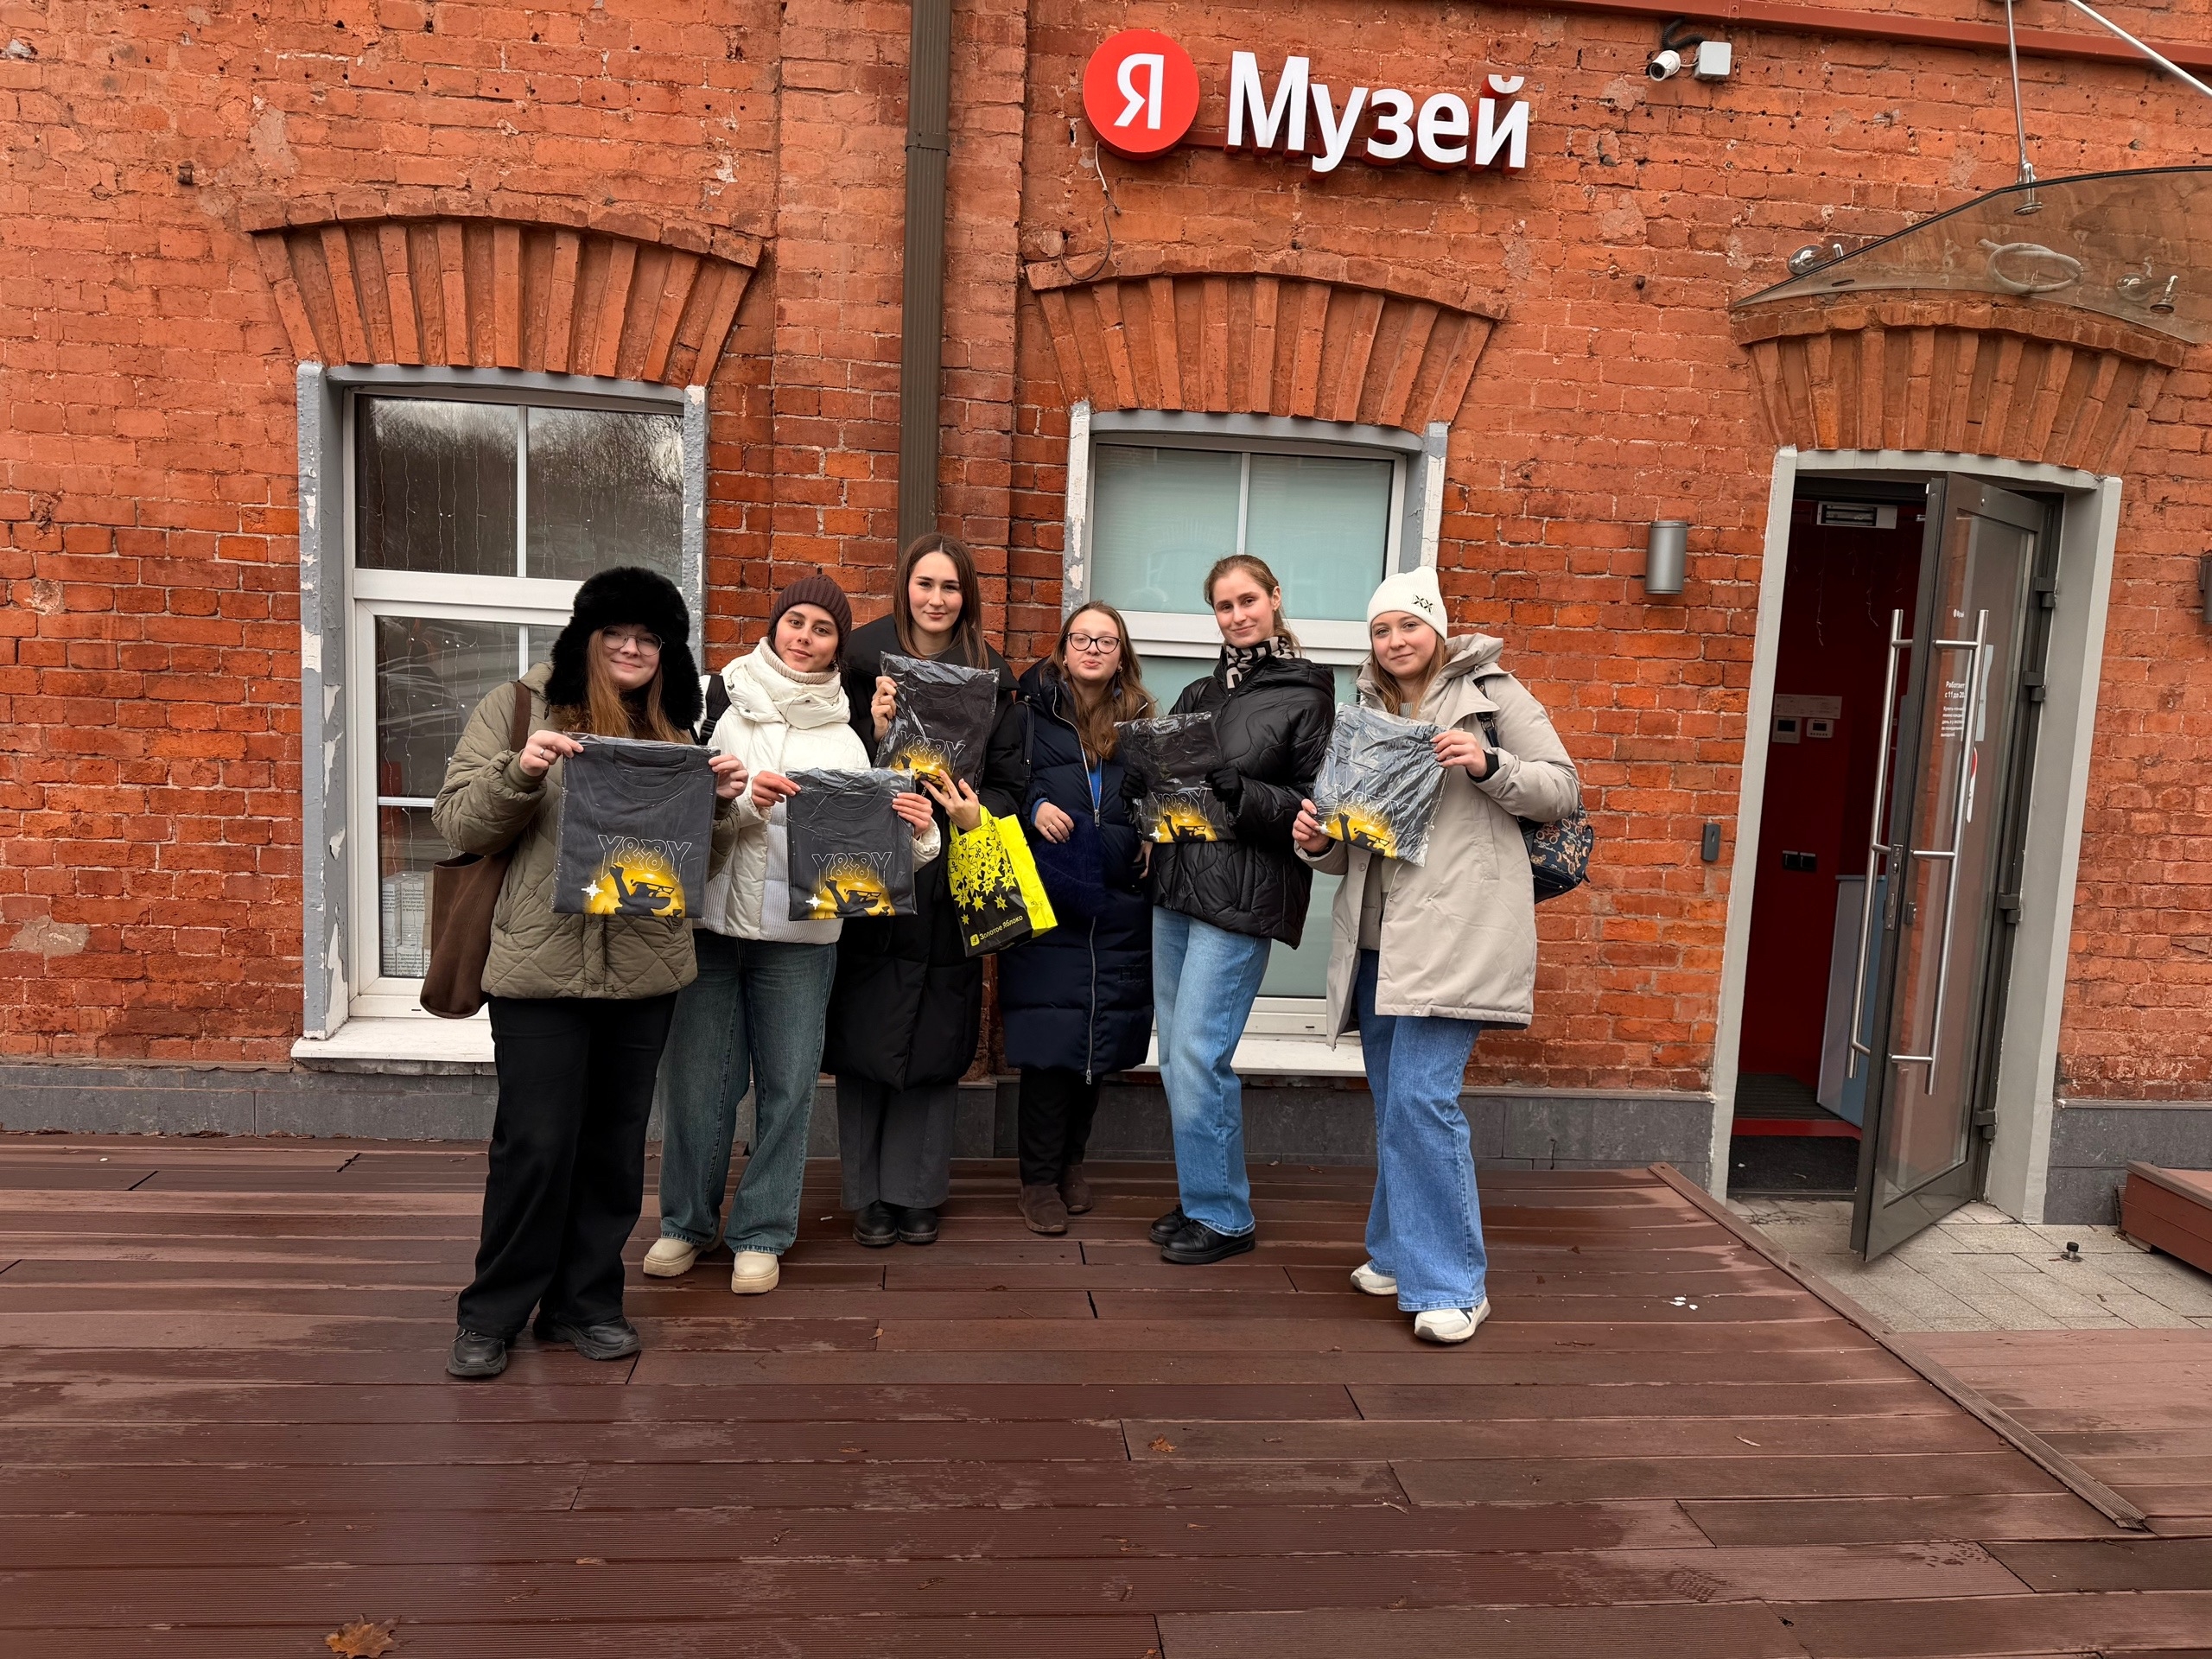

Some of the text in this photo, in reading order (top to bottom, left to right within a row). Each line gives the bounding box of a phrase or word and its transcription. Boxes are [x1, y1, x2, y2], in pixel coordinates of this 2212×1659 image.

[1114, 49, 1529, 175] Я Музей
[979, 914, 1023, 940] Золотое Яблоко
